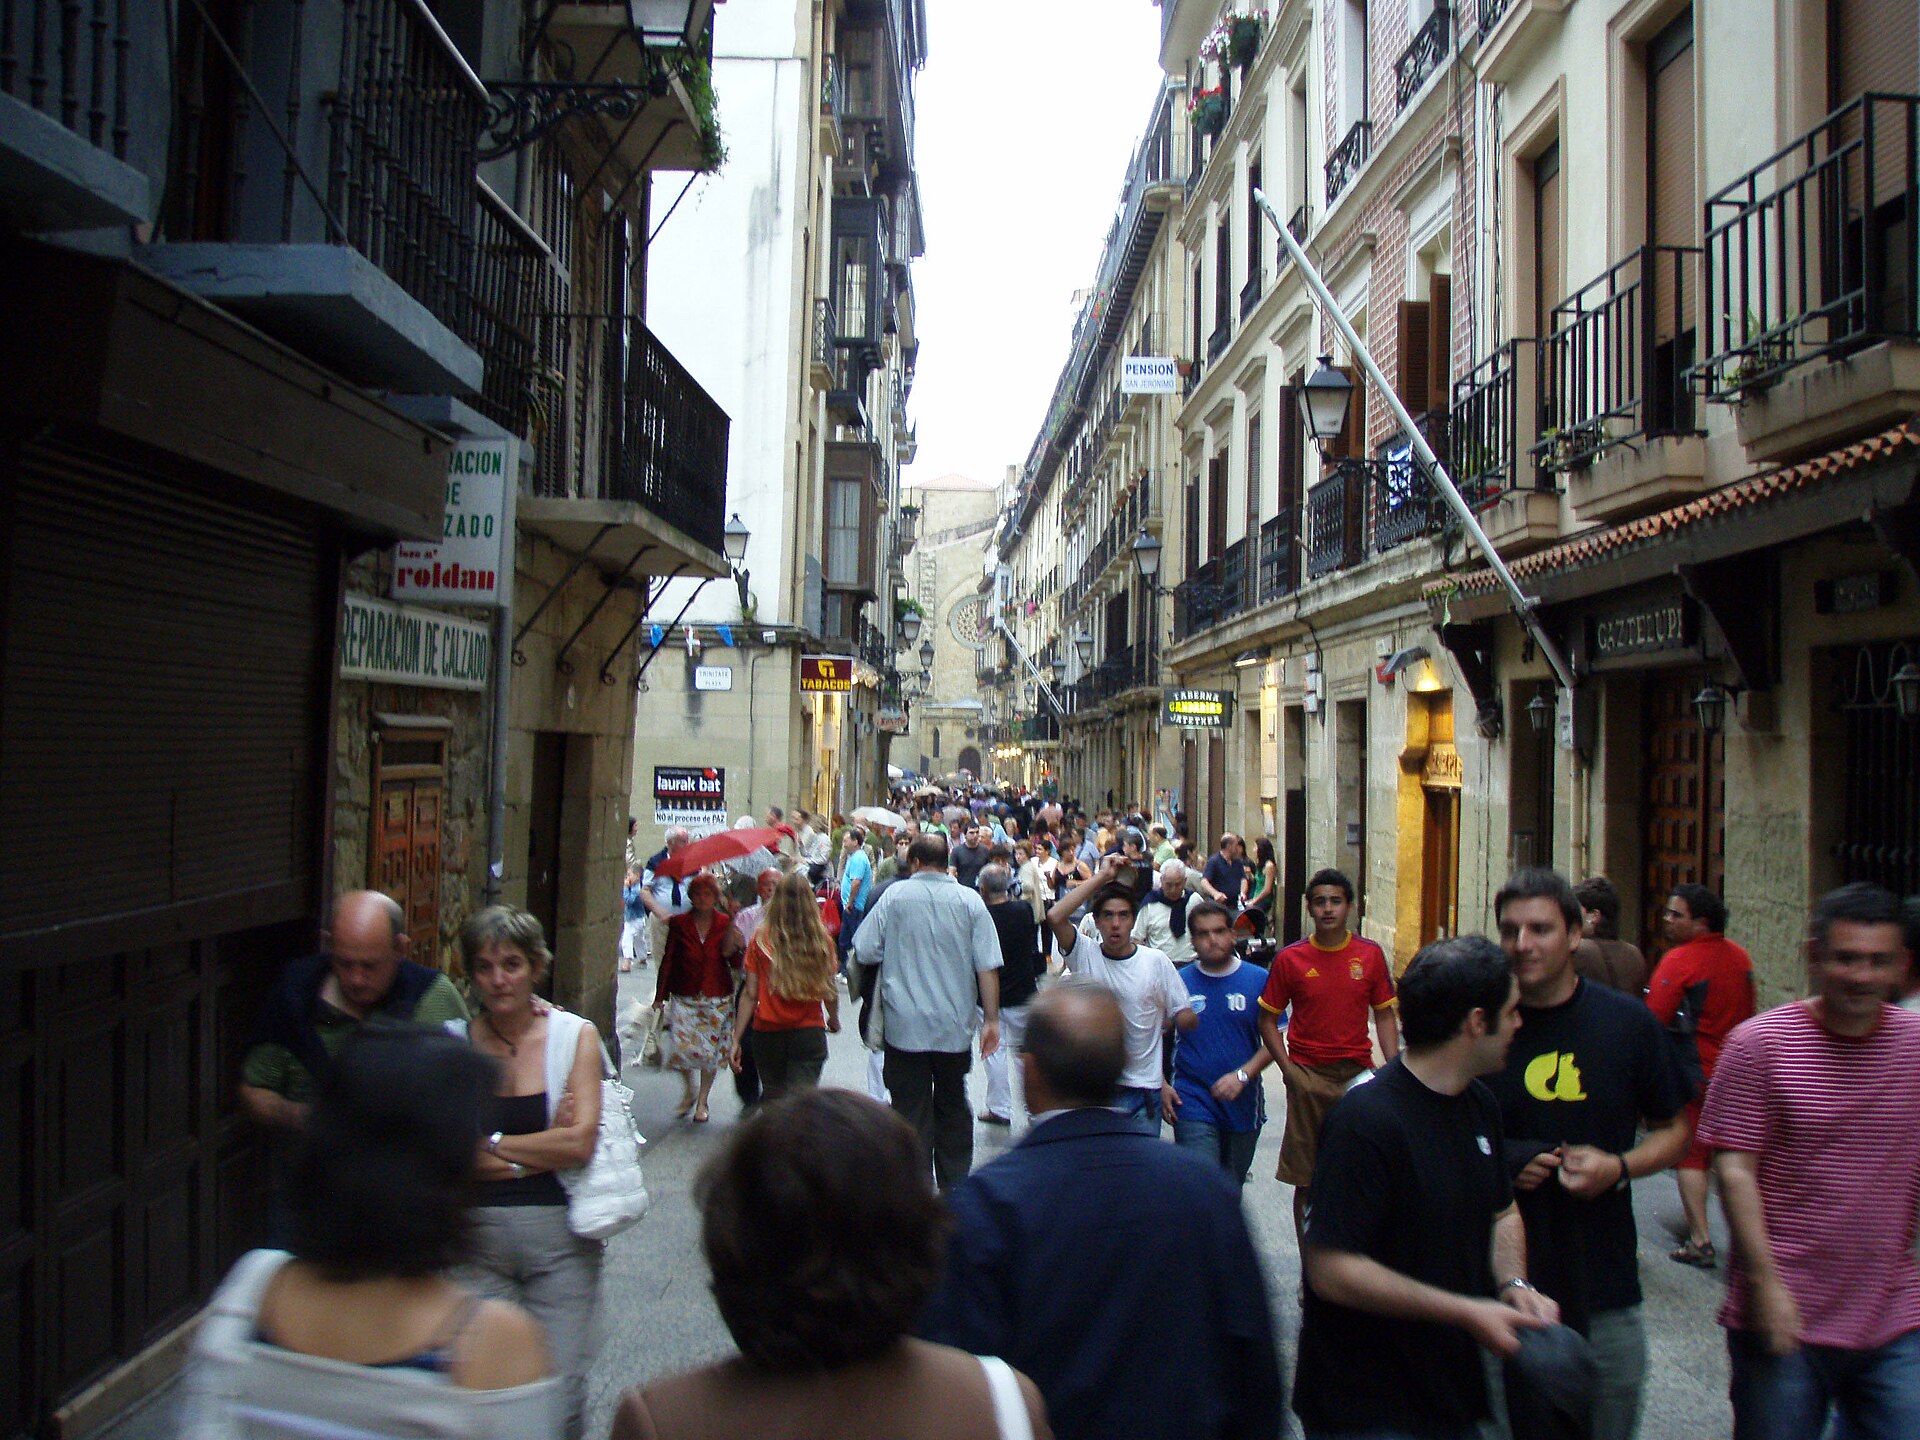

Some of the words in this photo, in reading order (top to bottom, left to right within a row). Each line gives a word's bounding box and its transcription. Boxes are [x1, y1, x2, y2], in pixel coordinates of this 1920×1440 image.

[1125, 363, 1174, 375] PENSION
[397, 562, 495, 591] roldan
[342, 606, 421, 674] REPARACION
[424, 621, 440, 677] DE
[442, 625, 487, 681] CALZADO
[801, 678, 851, 691] TABACOS
[1173, 690, 1219, 702] TABERNA
[657, 775, 696, 792] laurak
[699, 776, 721, 792] bat
[656, 811, 667, 822] NO
[674, 814, 701, 825] proceso
[702, 814, 711, 824] de
[712, 814, 725, 824] PAZ
[1225, 992, 1246, 1011] 10
